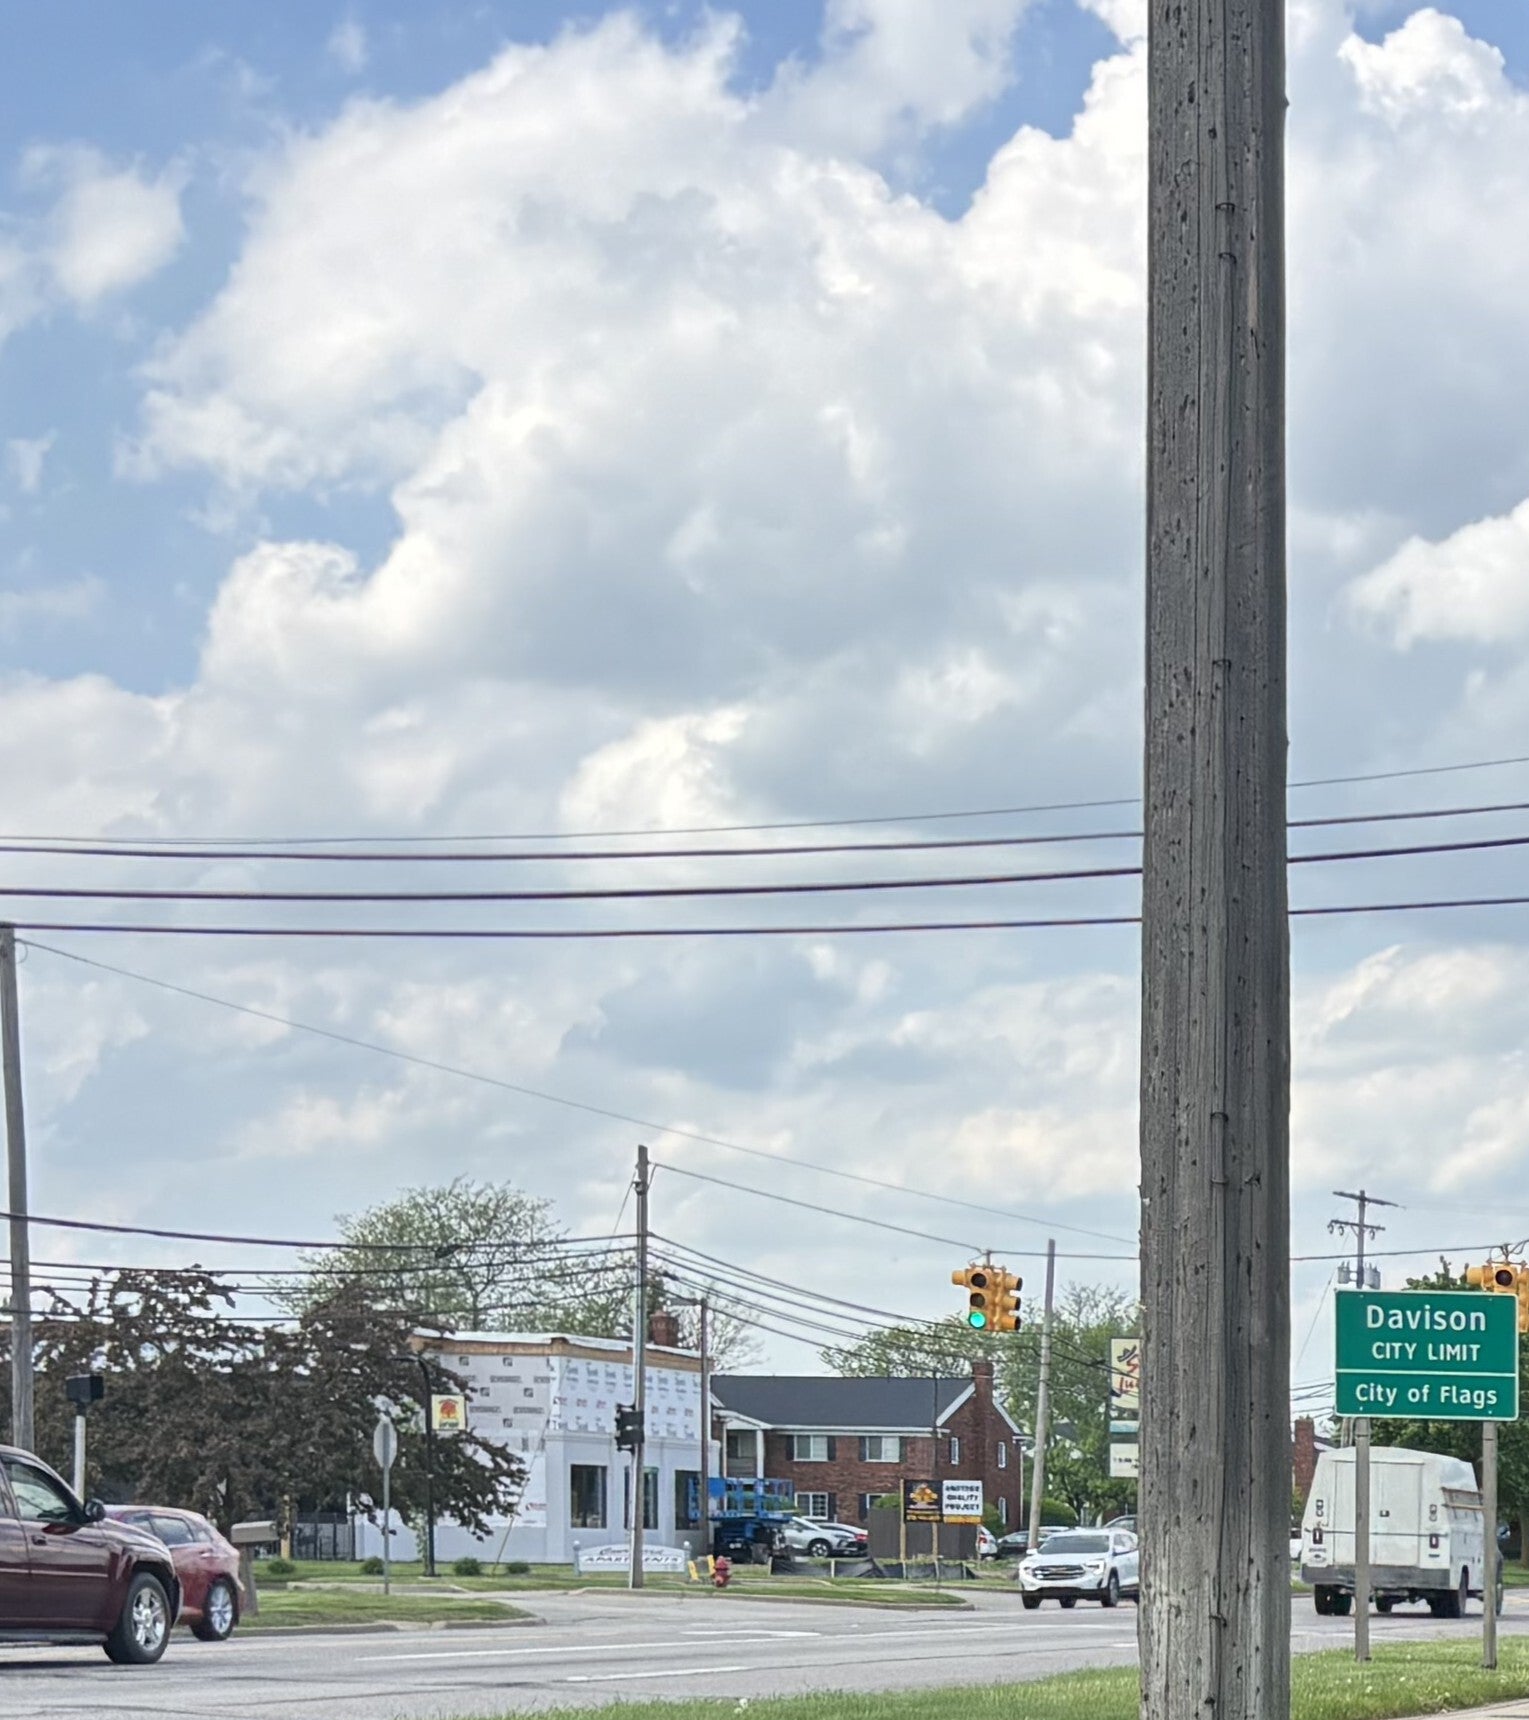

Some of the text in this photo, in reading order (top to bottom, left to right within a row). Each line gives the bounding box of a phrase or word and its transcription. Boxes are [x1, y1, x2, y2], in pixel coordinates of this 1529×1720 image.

[1366, 1304, 1487, 1332] Davison
[1371, 1341, 1481, 1362] CITY LIMIT
[1354, 1382, 1498, 1410] City of Flags
